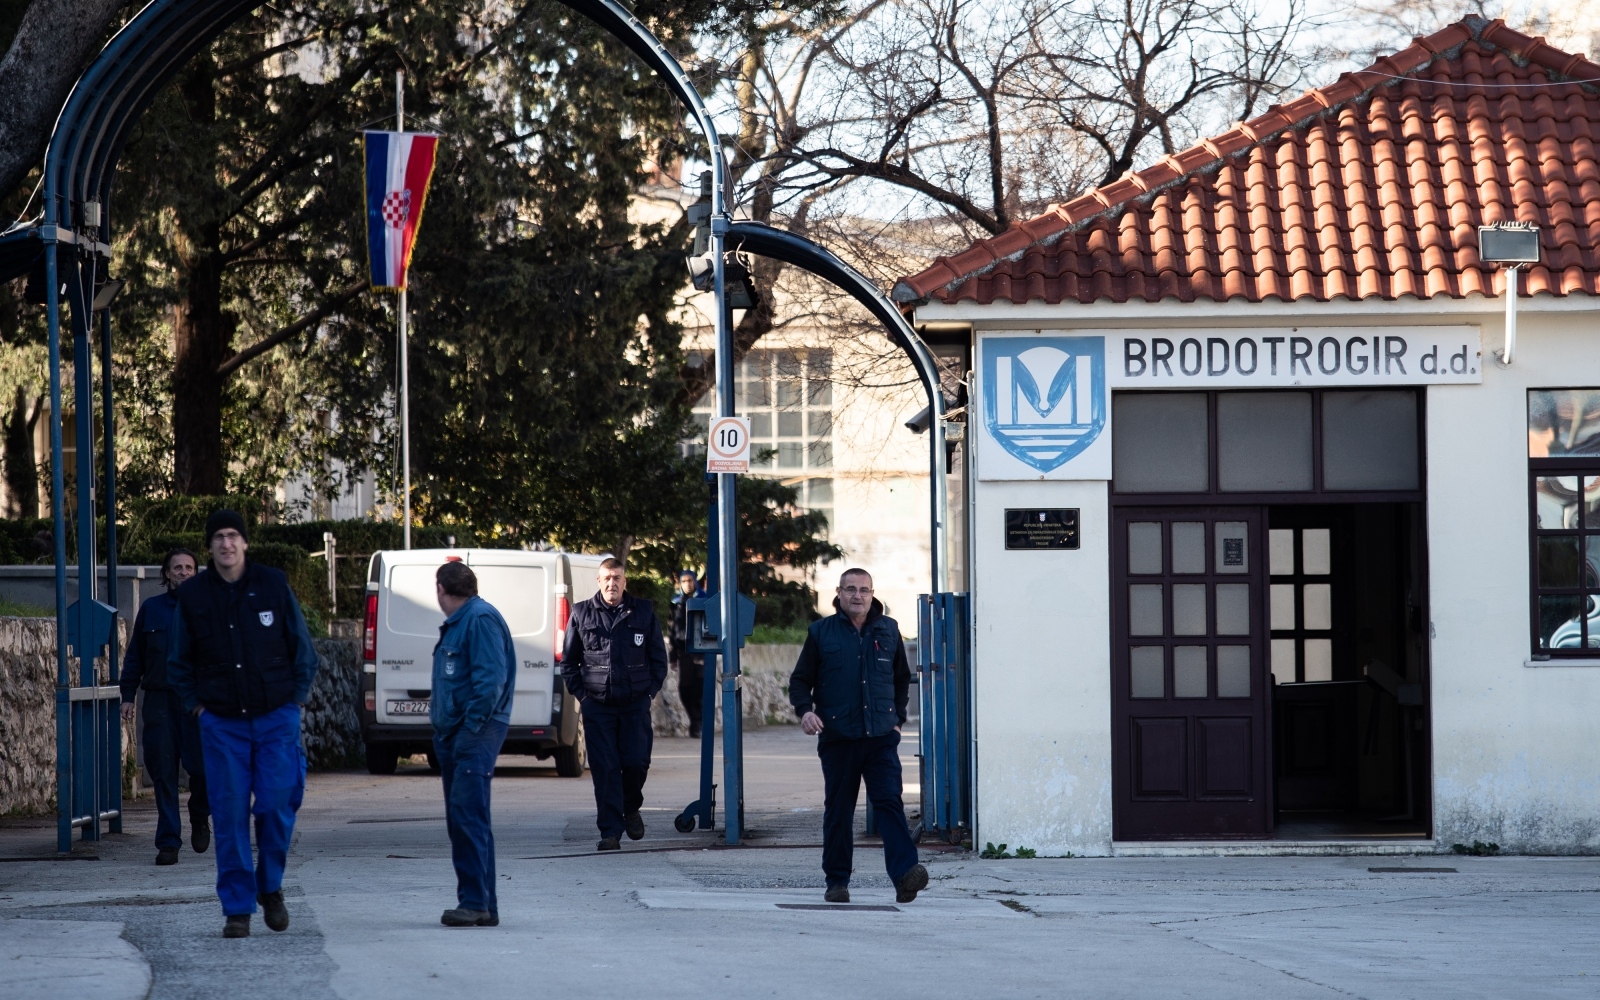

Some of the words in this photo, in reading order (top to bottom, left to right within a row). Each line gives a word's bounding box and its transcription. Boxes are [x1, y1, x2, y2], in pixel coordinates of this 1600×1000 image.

[1124, 336, 1407, 377] BRODOTROGIR
[1420, 345, 1475, 374] d.d.
[720, 429, 738, 447] 10
[523, 660, 549, 668] Trafic
[394, 702, 405, 713] ZG
